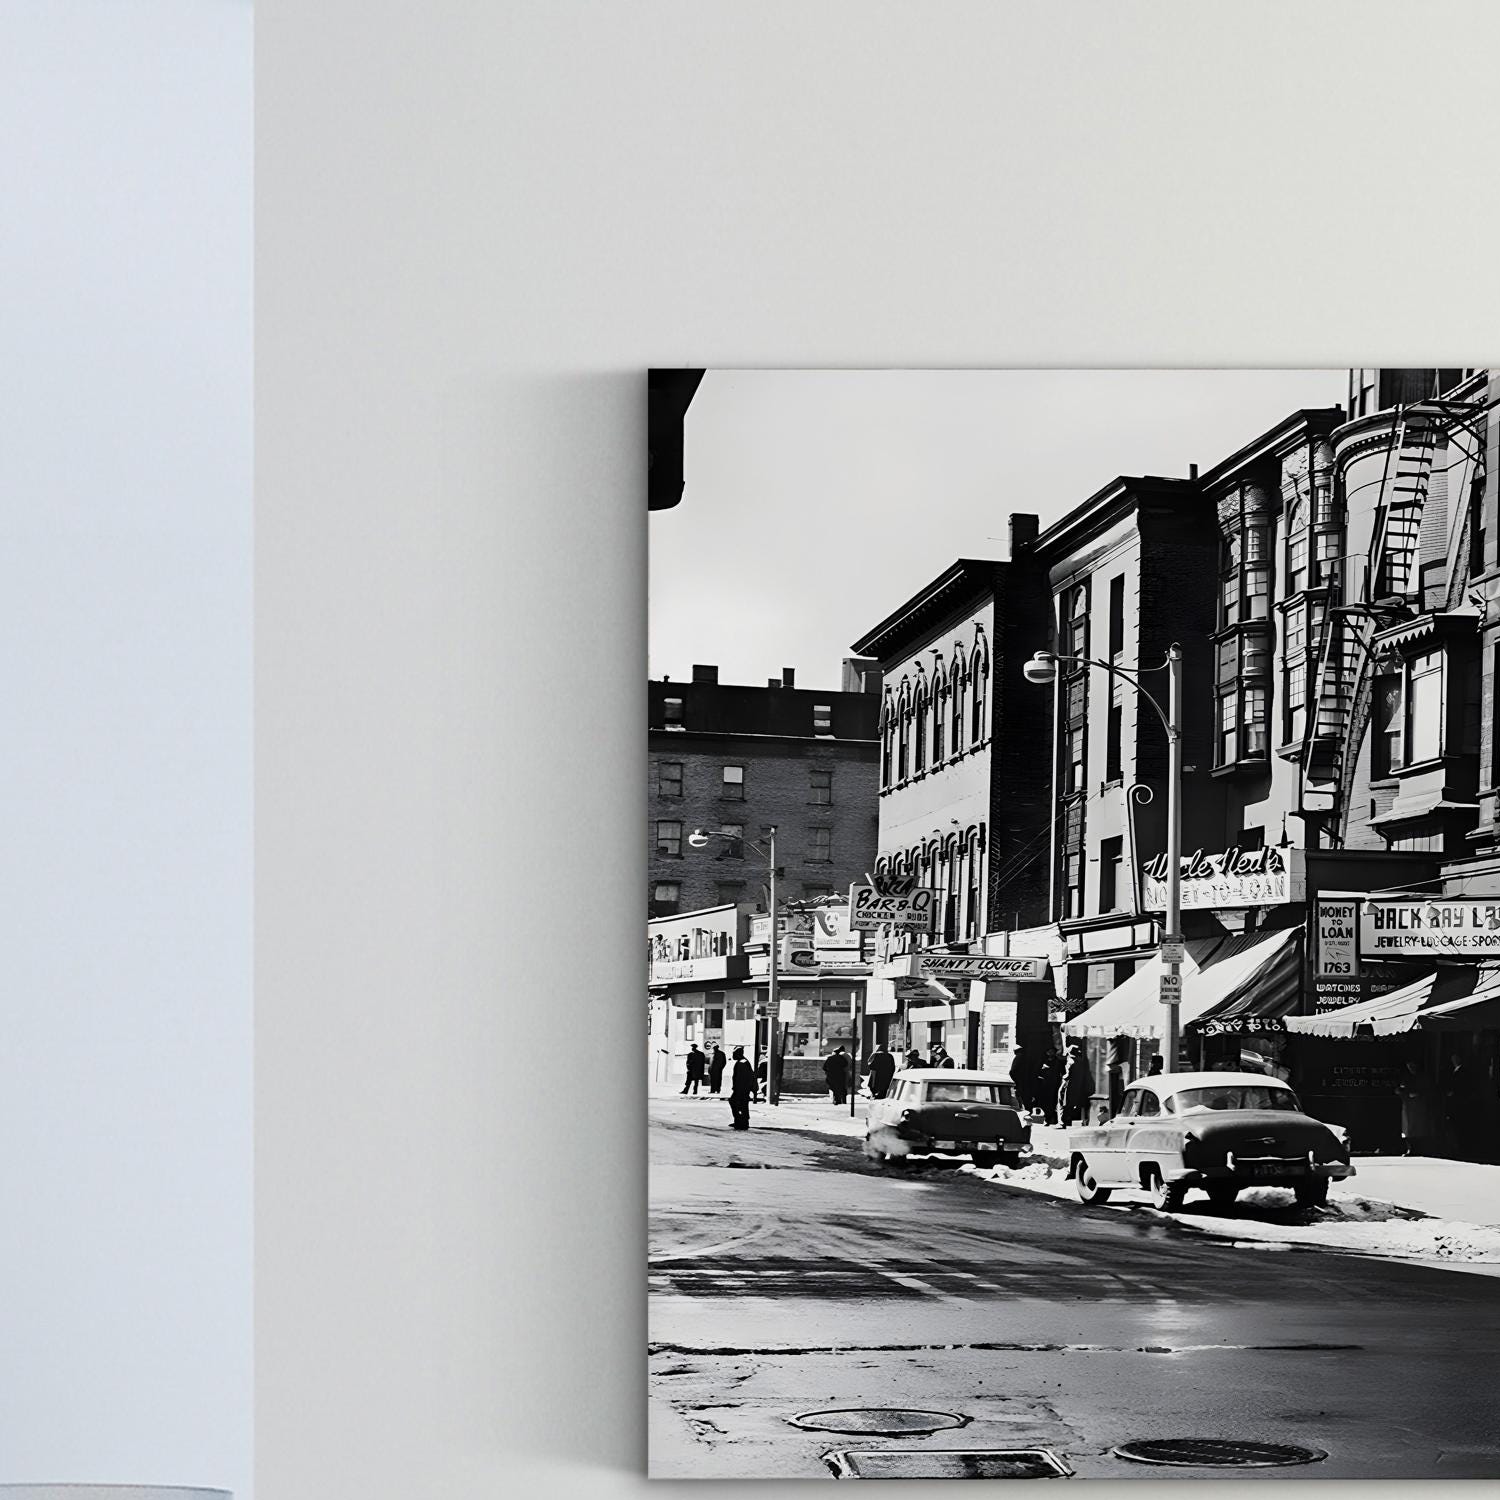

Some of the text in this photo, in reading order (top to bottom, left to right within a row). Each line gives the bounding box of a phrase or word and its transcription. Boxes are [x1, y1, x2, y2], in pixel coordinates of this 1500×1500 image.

[1144, 848, 1213, 878] Ucle
[1320, 906, 1354, 918] MONEY
[1374, 908, 1422, 929] BACK
[1322, 927, 1353, 938] LOAN
[920, 958, 1033, 971] SHANTY LOUNGE
[1324, 962, 1351, 973] 1763
[1163, 976, 1178, 986] NO
